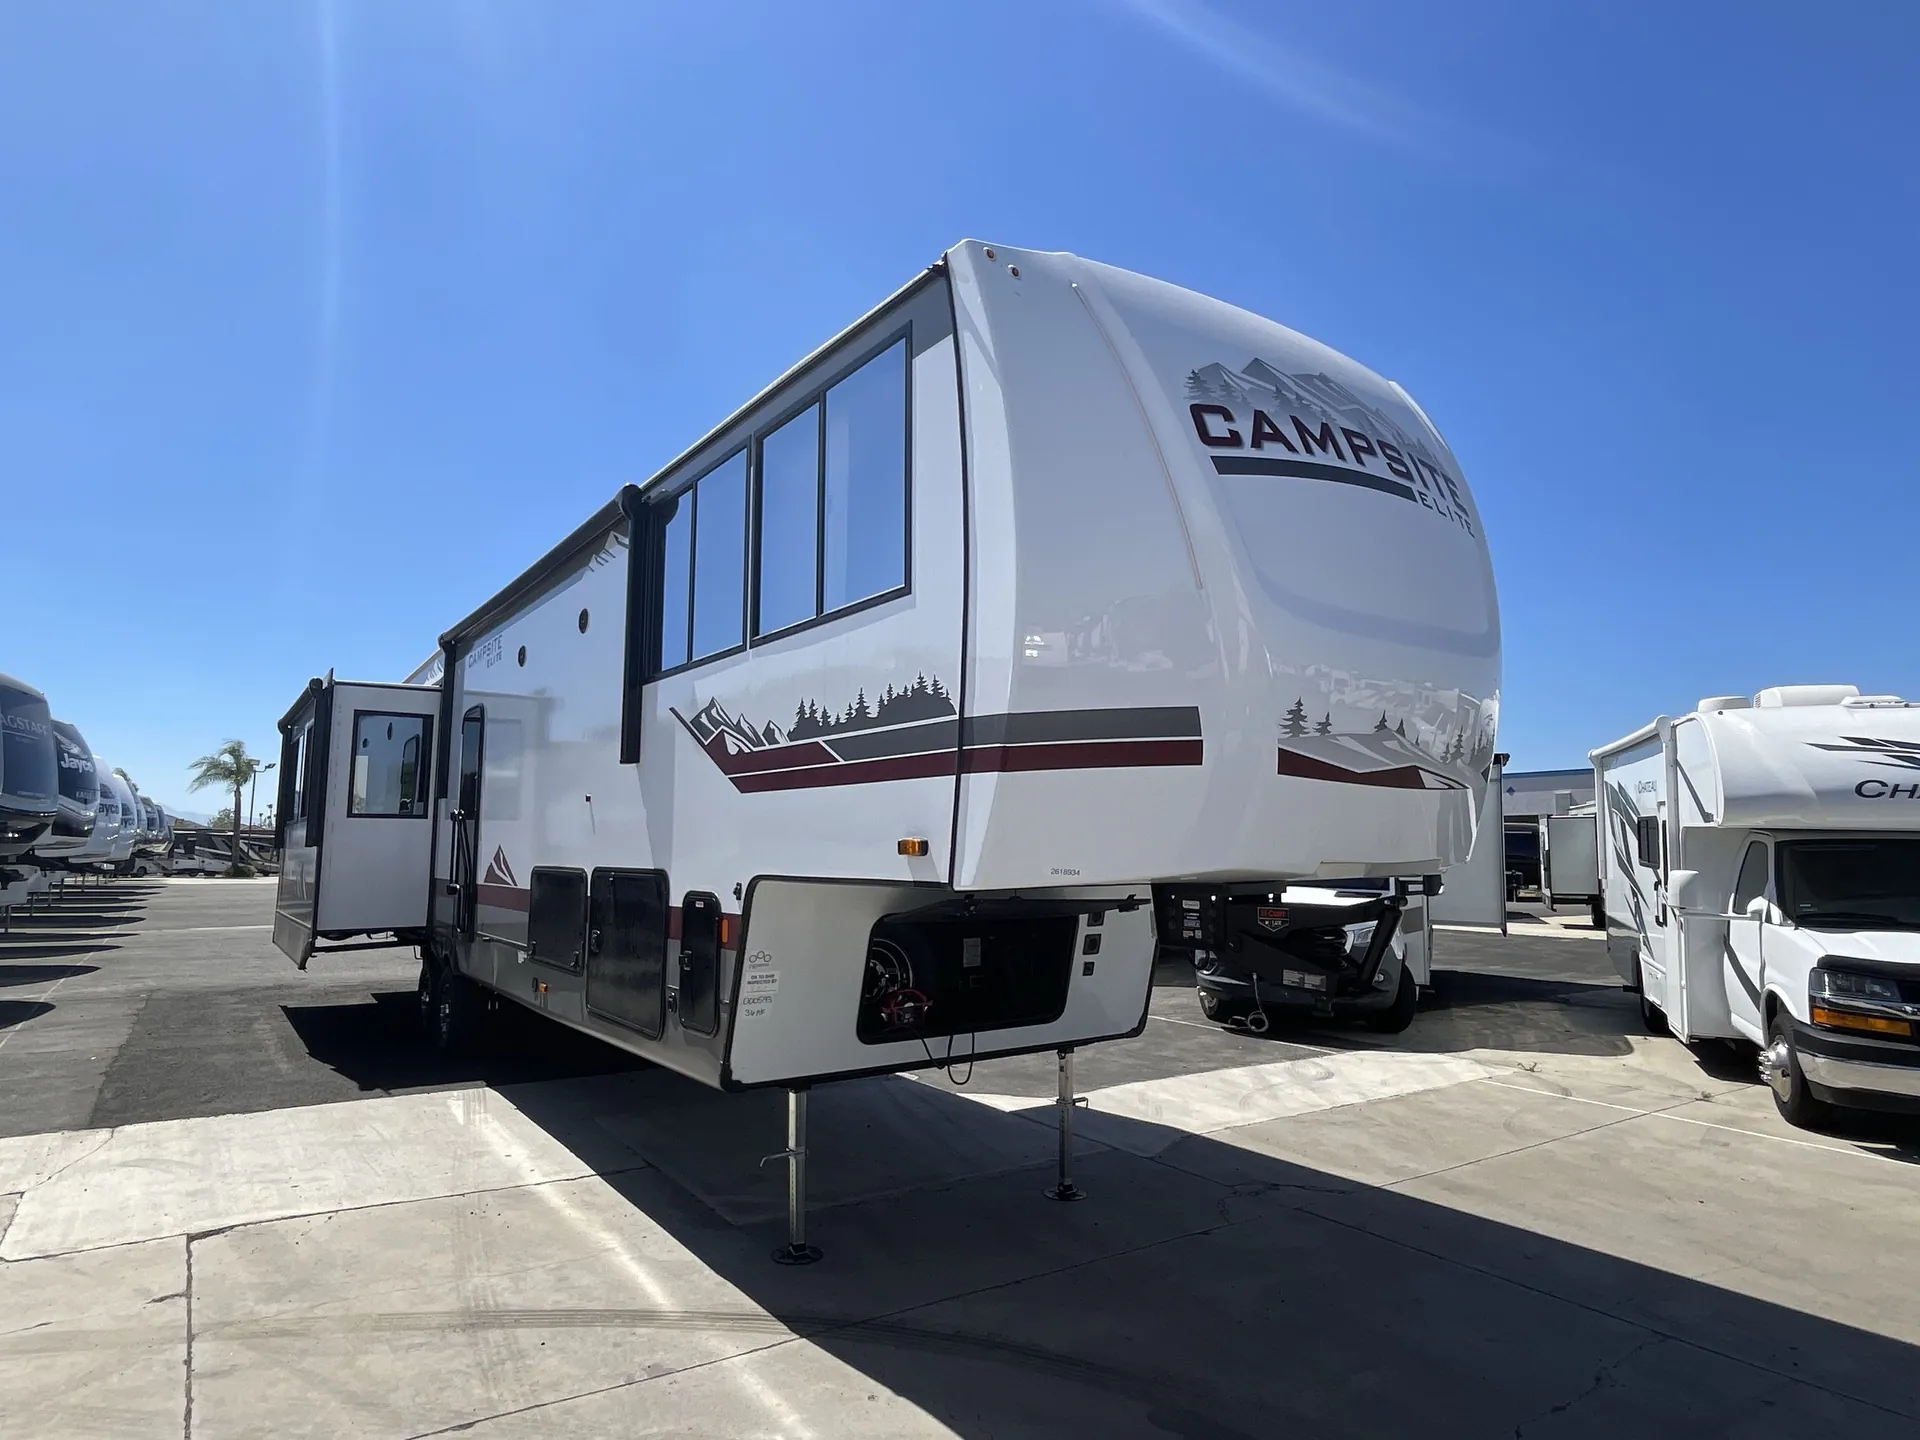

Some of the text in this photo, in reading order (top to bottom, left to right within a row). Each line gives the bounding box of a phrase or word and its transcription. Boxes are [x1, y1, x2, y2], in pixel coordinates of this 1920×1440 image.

[1189, 403, 1469, 518] CAMPSITE
[1416, 489, 1476, 539] ELITE
[468, 634, 502, 668] CAMPSITE
[486, 650, 502, 668] ELITE
[0, 713, 48, 736] AGSTAFF
[60, 752, 94, 773] Jayco
[1854, 779, 1920, 799] CH
[99, 803, 119, 816] ayco
[1050, 867, 1081, 876] 2618934
